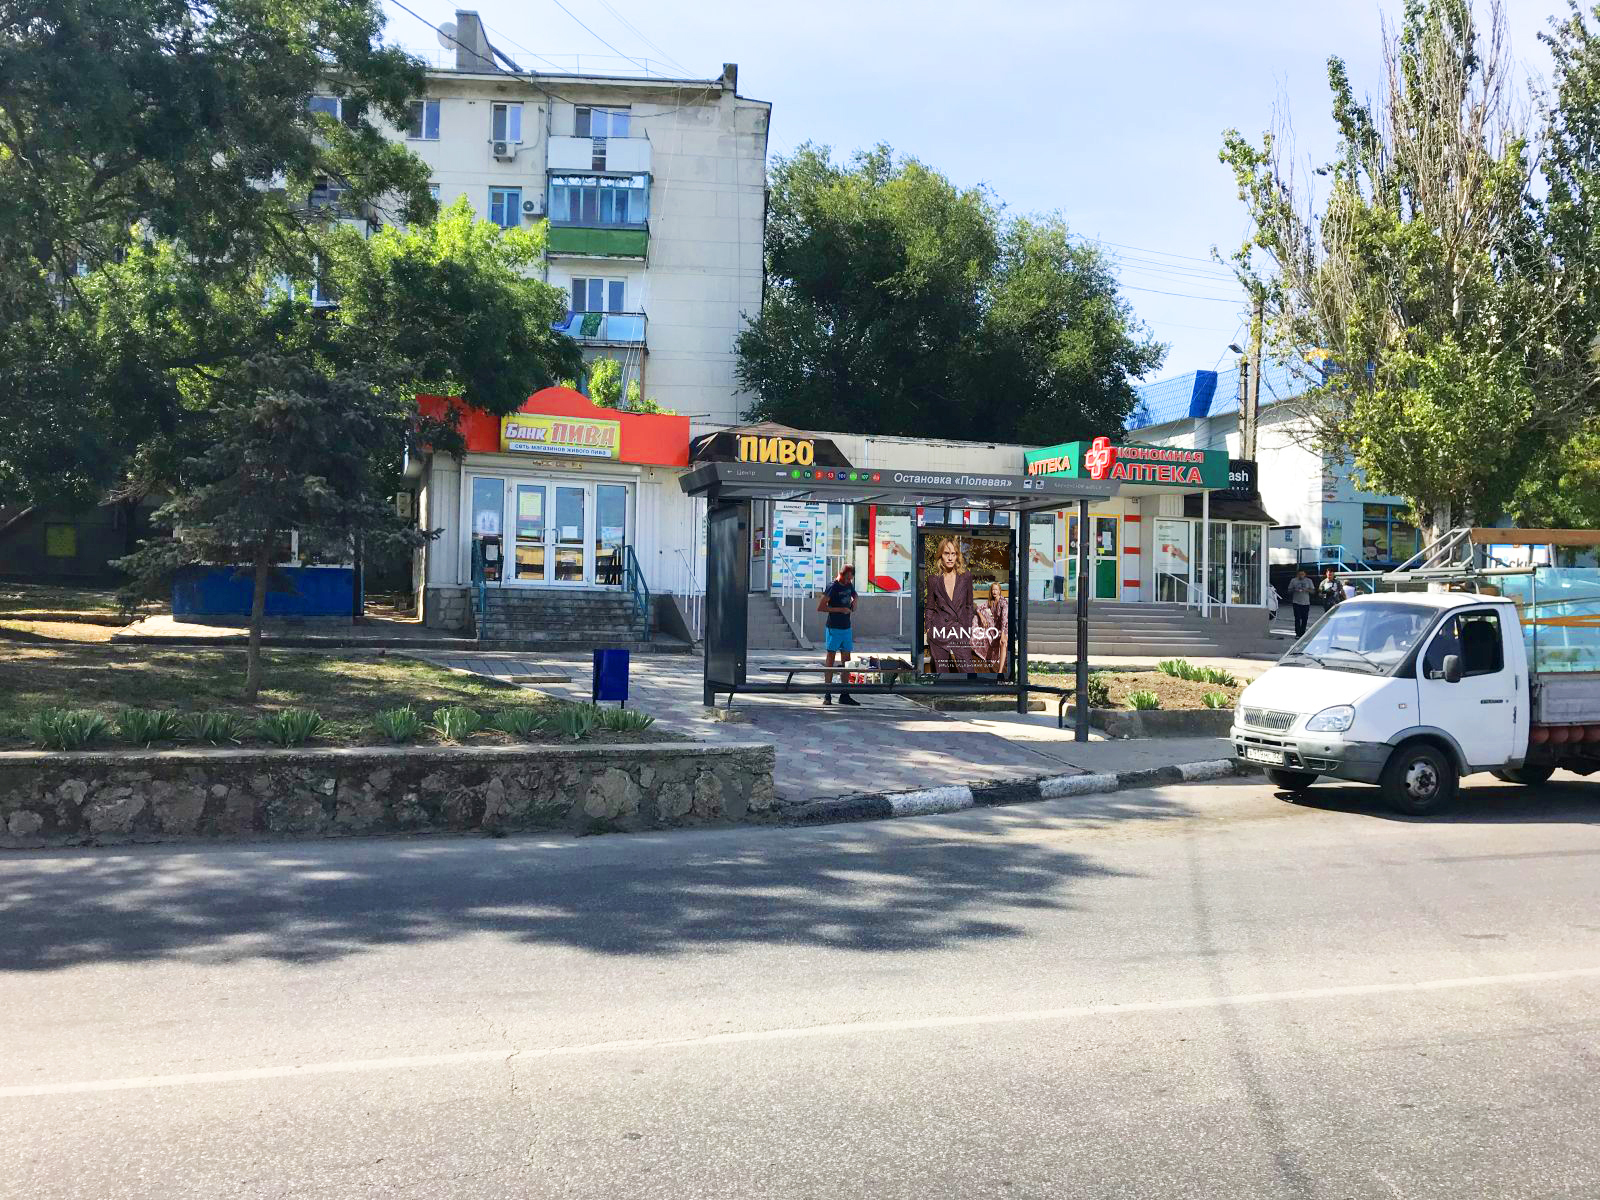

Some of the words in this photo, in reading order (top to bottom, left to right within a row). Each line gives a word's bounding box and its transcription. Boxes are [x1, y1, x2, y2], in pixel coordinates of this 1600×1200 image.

[551, 422, 616, 448] ПИВА
[531, 444, 566, 454] магазинов
[566, 447, 590, 455] живого
[739, 436, 814, 465] ПИВО
[1114, 446, 1205, 464] КОНОМНАЯ
[1028, 456, 1071, 477] АПТЕКА
[1111, 462, 1204, 485] АПТЕКА
[893, 471, 952, 485] Остановка
[954, 475, 1013, 488] «Полевая»
[933, 626, 999, 640] MANGO
